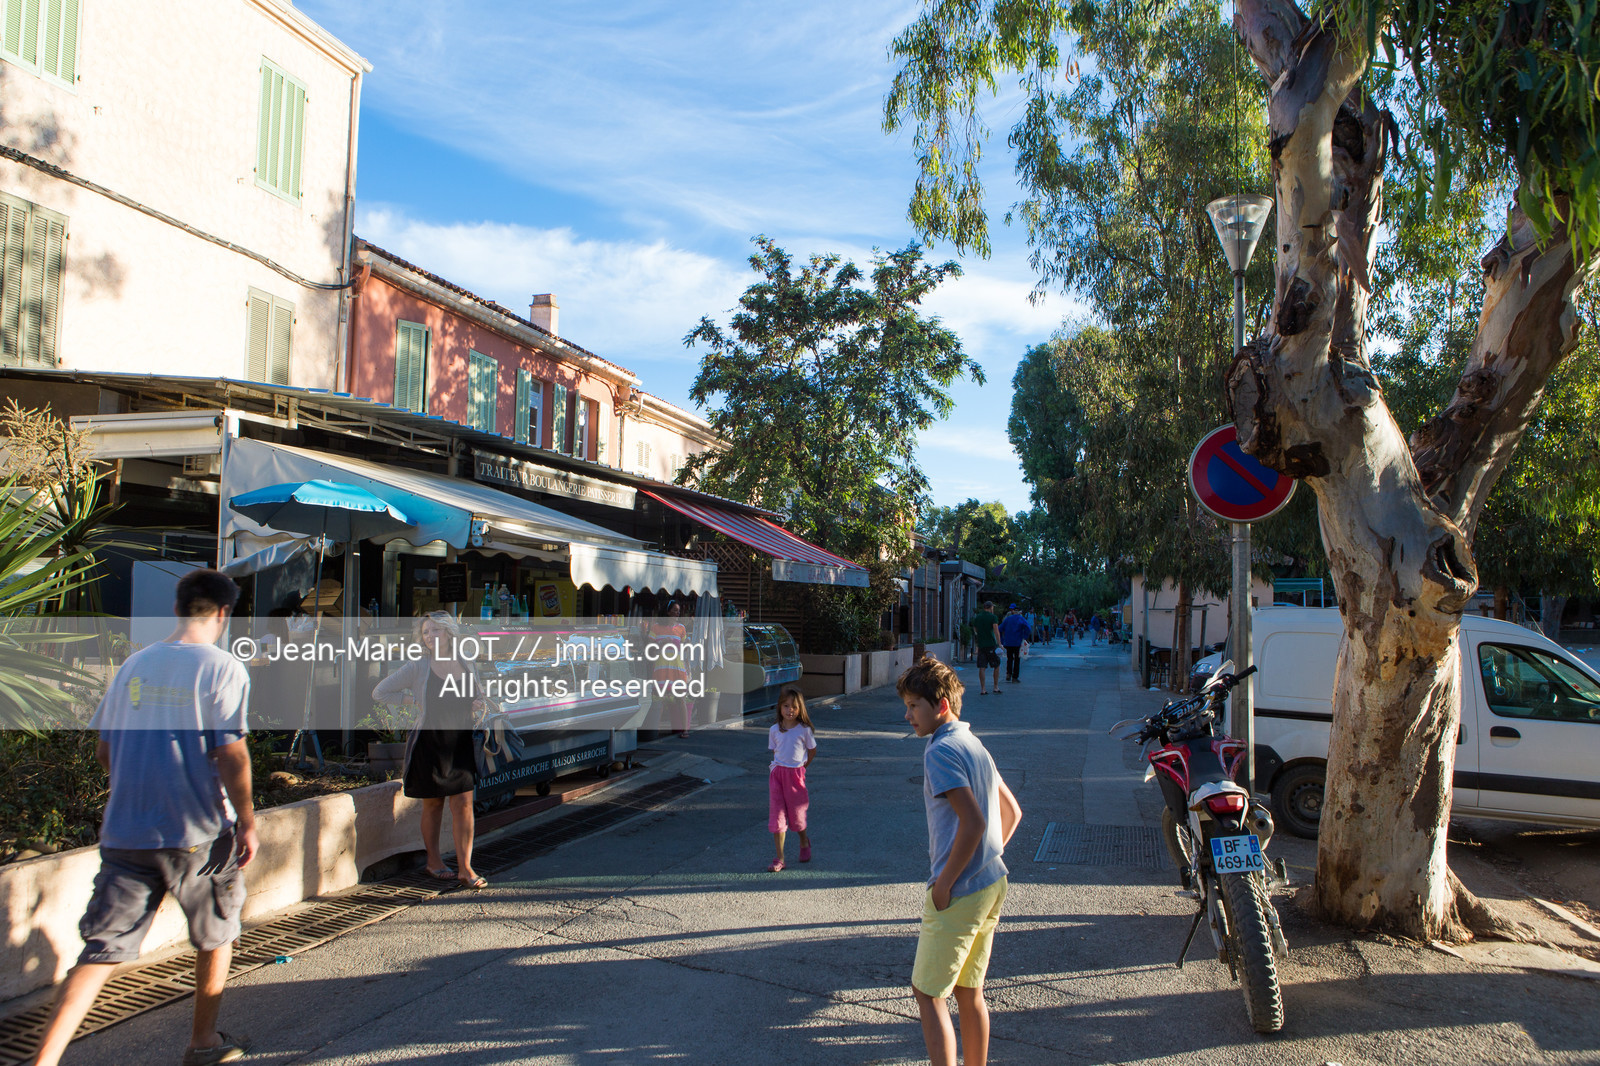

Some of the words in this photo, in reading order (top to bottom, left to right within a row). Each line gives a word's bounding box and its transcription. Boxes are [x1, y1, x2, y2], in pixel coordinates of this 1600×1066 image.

[480, 462, 528, 485] TRAITEUR
[530, 473, 586, 497] BOULANGERIE
[587, 486, 624, 504] PATISSERIE
[479, 770, 511, 789] MAISON
[512, 760, 549, 780] SARROCHE
[551, 754, 576, 769] MAISON
[577, 746, 607, 762] SARROCHE
[1217, 854, 1262, 869] 469-AC
